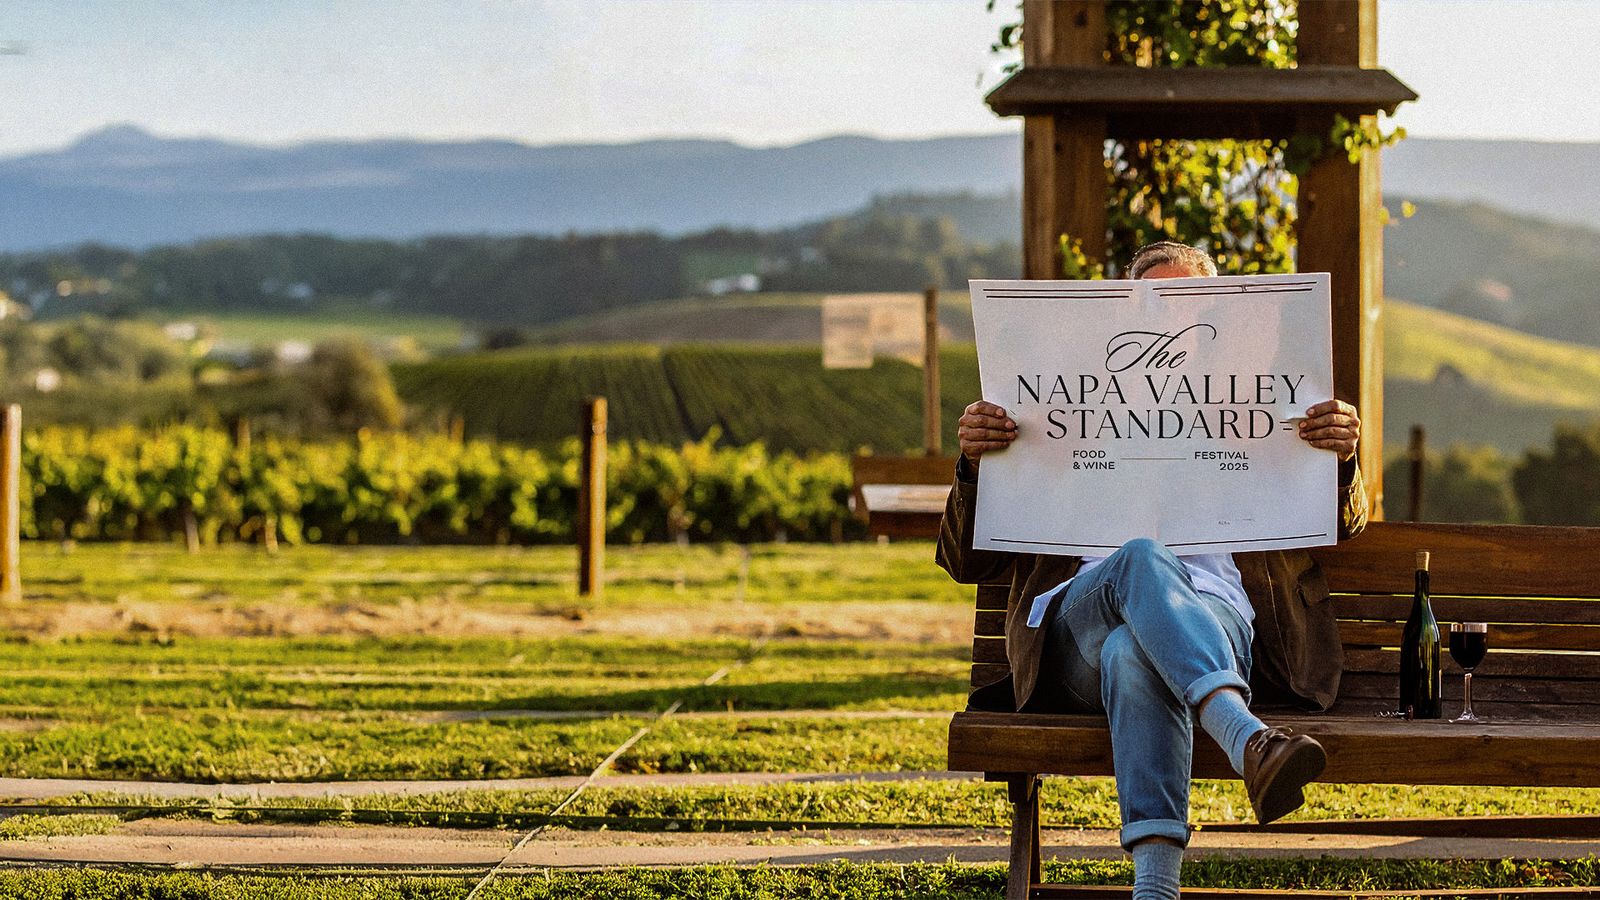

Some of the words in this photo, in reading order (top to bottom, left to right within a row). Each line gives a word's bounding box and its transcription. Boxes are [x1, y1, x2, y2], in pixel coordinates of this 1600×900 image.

[1105, 323, 1217, 373] The
[1016, 374, 1128, 405] NAPA
[1144, 374, 1305, 405] VALLEY
[1046, 408, 1275, 440] STANDARD
[1072, 449, 1107, 459] FOOD
[1194, 450, 1250, 460] FESTIVAL
[1072, 461, 1081, 470] &
[1082, 461, 1116, 470] WINE
[1219, 462, 1249, 471] 2025
